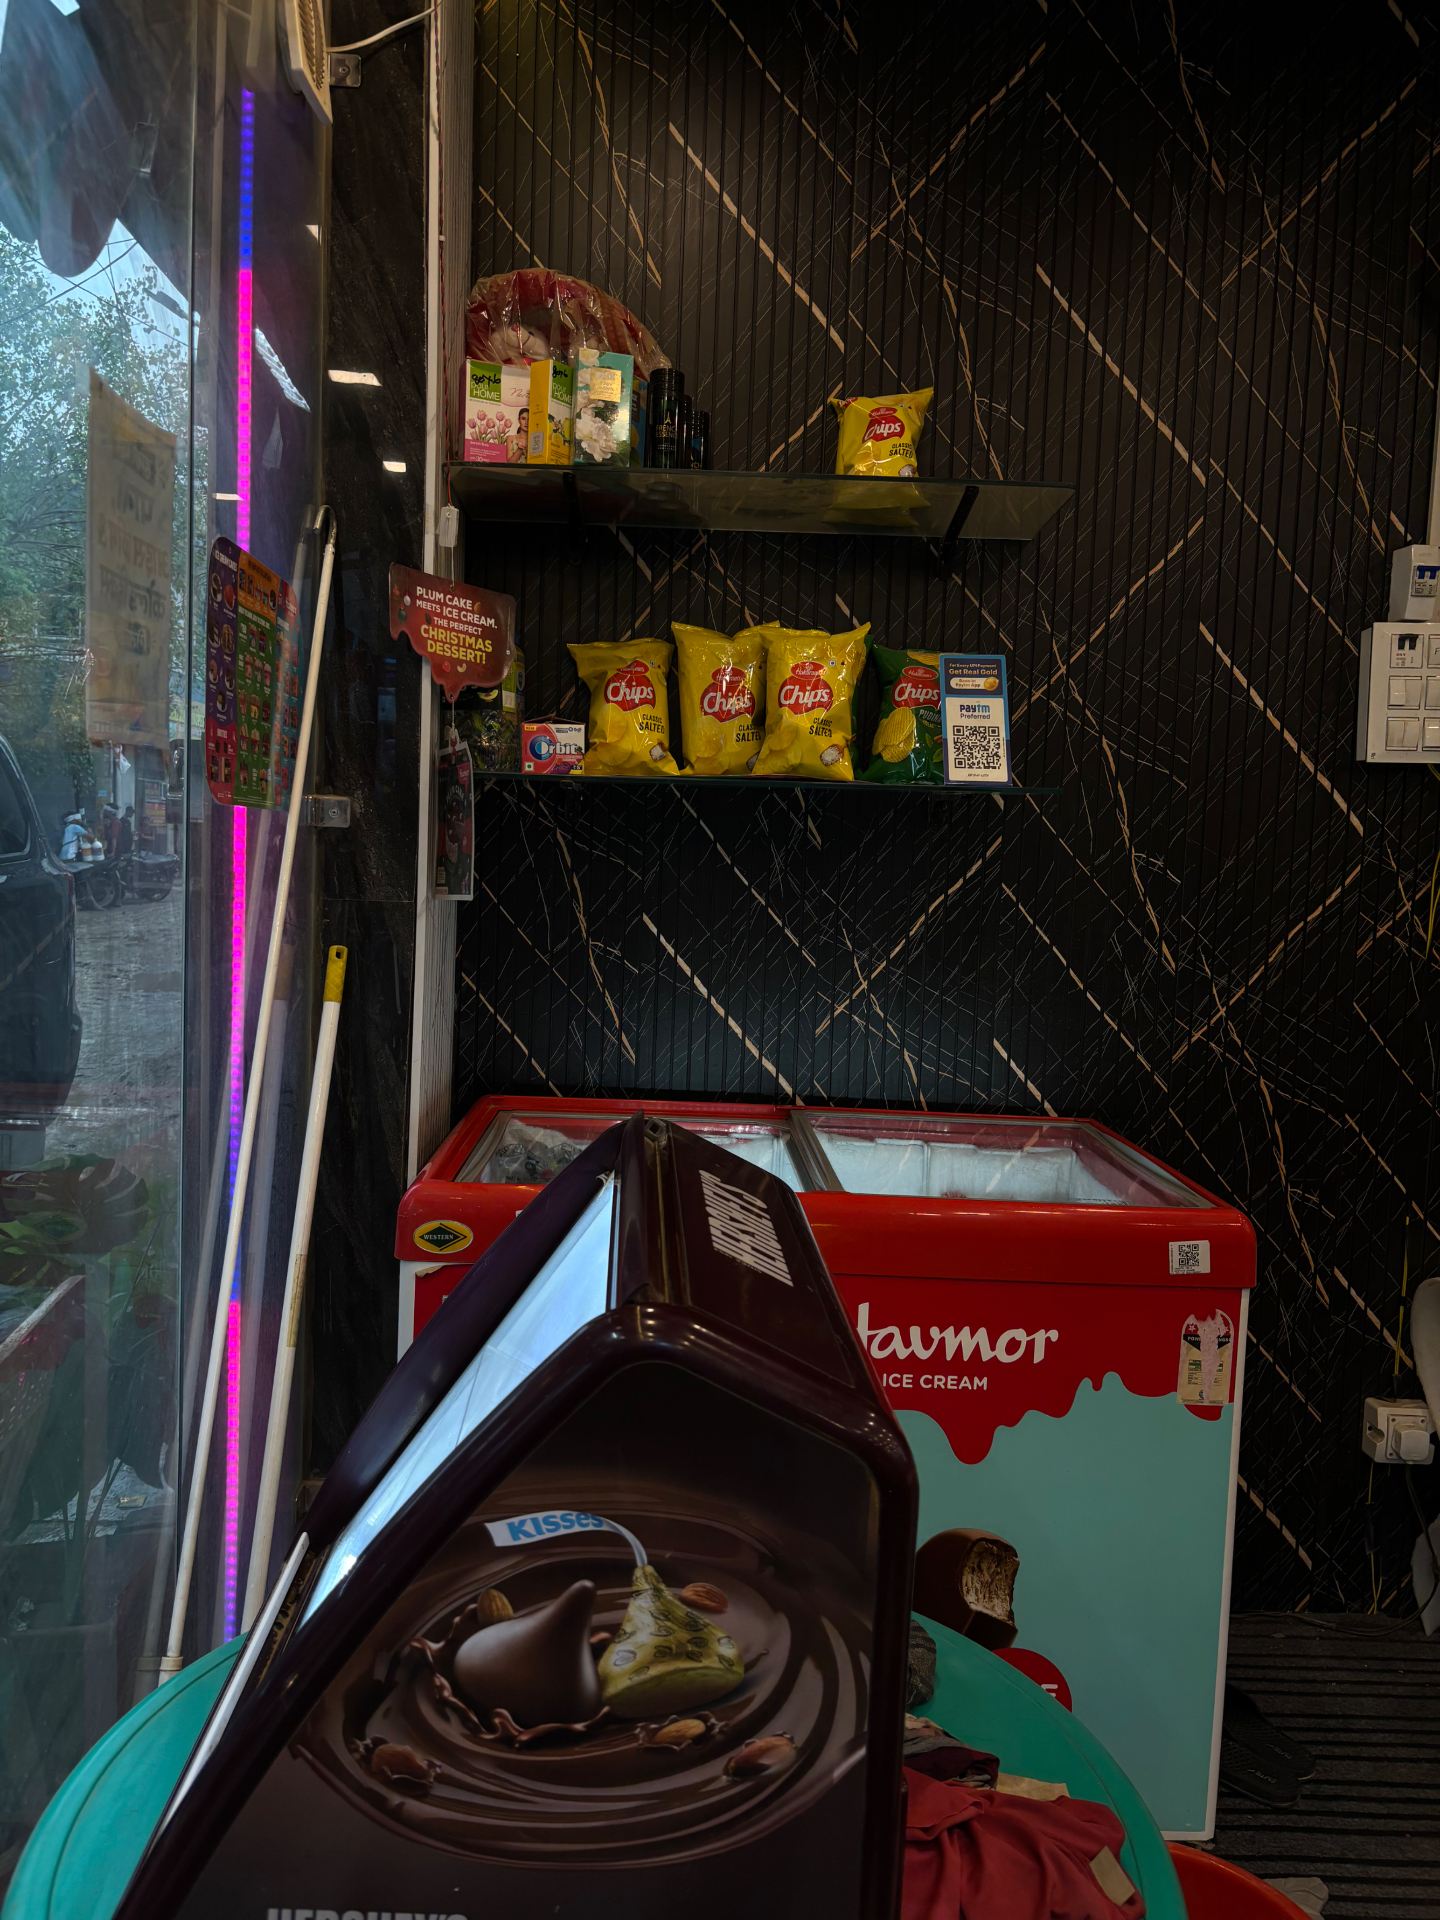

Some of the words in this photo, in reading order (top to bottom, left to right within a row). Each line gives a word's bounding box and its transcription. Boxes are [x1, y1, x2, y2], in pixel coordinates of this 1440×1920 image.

[473, 388, 501, 401] HOME
[553, 389, 572, 404] HOME
[889, 449, 914, 459] SALTED
[416, 586, 444, 603] PLUM
[445, 594, 473, 610] CAKE
[416, 598, 441, 613] MEETS
[442, 607, 459, 620] ICE
[460, 611, 498, 629] CREAM.
[433, 616, 449, 628] THE
[449, 620, 483, 636] PERFECT
[420, 624, 493, 653] CHRISTMAS
[427, 640, 486, 665] DESSERT!
[606, 680, 654, 704] Chips
[780, 685, 830, 708] Chips
[894, 683, 940, 703] Chips
[703, 691, 752, 715] Chips
[959, 704, 990, 713] paytm
[639, 721, 665, 734] SALTED
[809, 725, 833, 738] SALTED
[529, 735, 578, 761] Orbit
[698, 1169, 795, 1288] HERSHEY'S
[882, 1373, 914, 1388] ICE
[919, 1374, 988, 1391] CREAM
